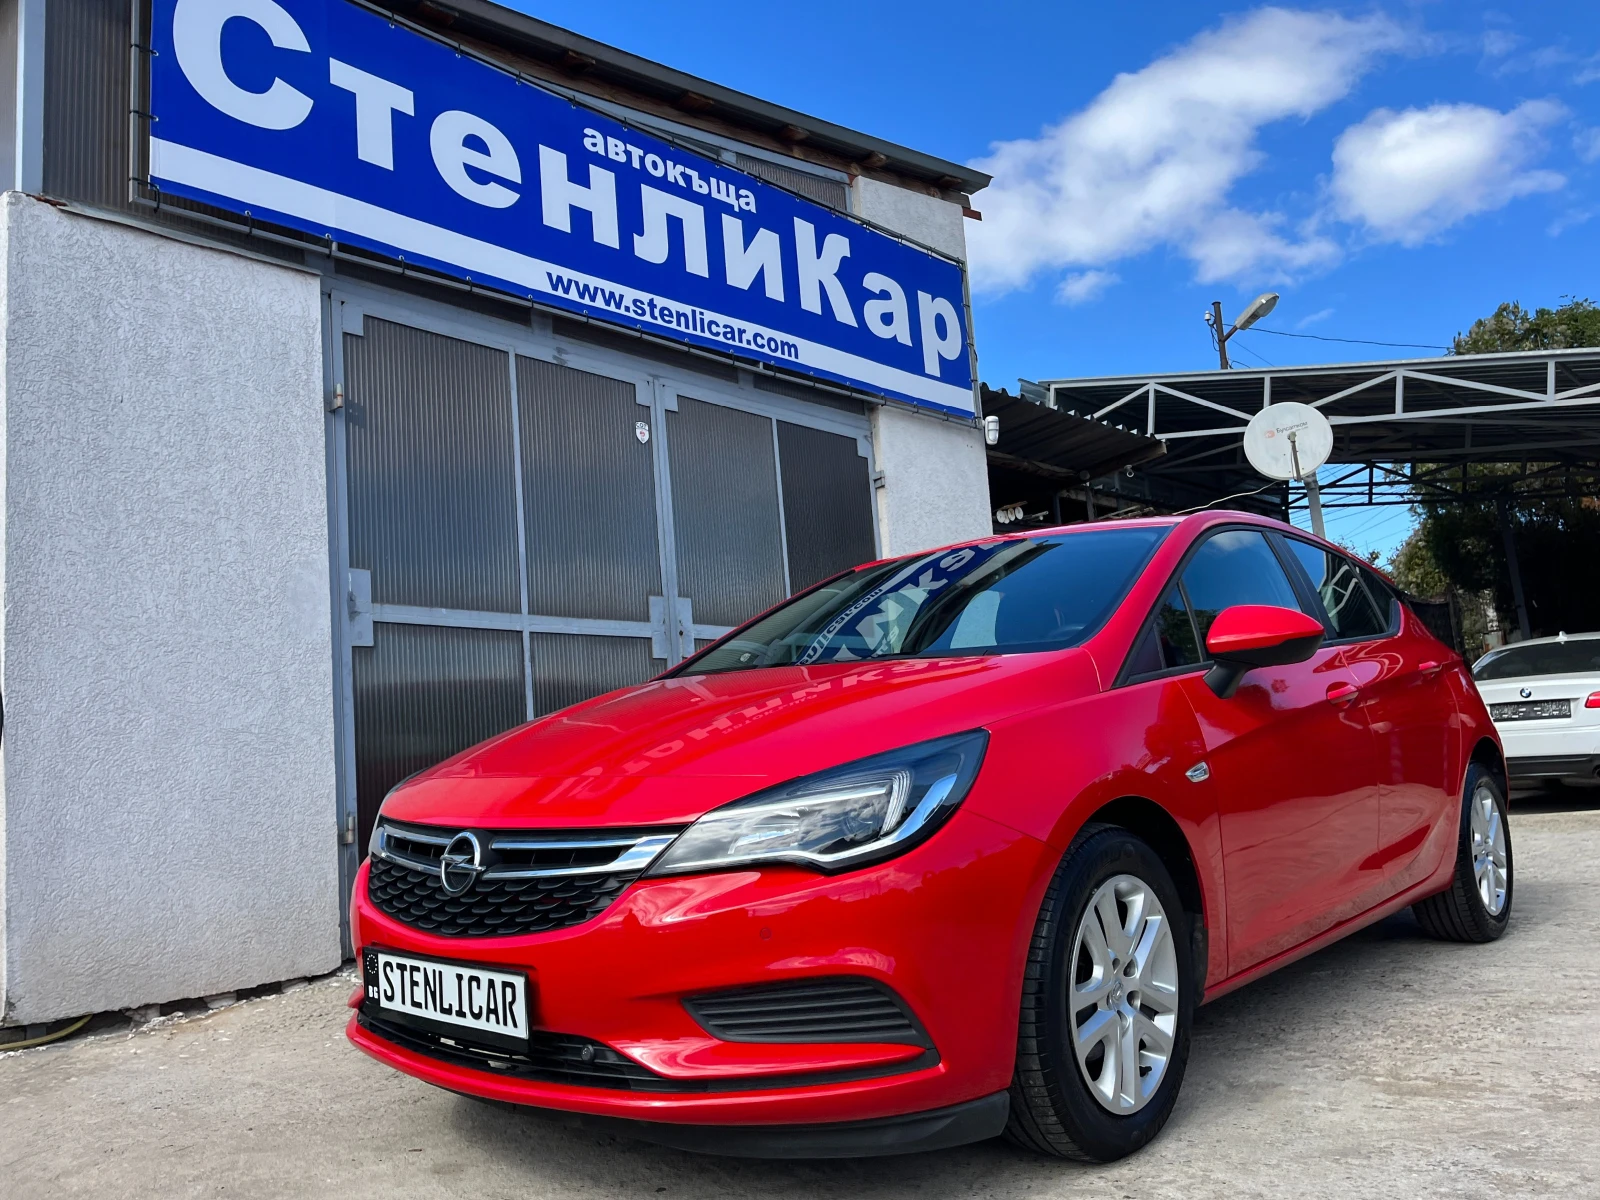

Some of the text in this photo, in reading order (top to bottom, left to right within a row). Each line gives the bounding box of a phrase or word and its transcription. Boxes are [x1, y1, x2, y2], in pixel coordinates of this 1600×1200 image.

[173, 0, 962, 378] СтенлиКар
[584, 127, 757, 213] автокъща
[546, 272, 799, 360] www.stenlicar.com
[368, 985, 379, 999] BG
[383, 961, 518, 1029] STENLICAR
